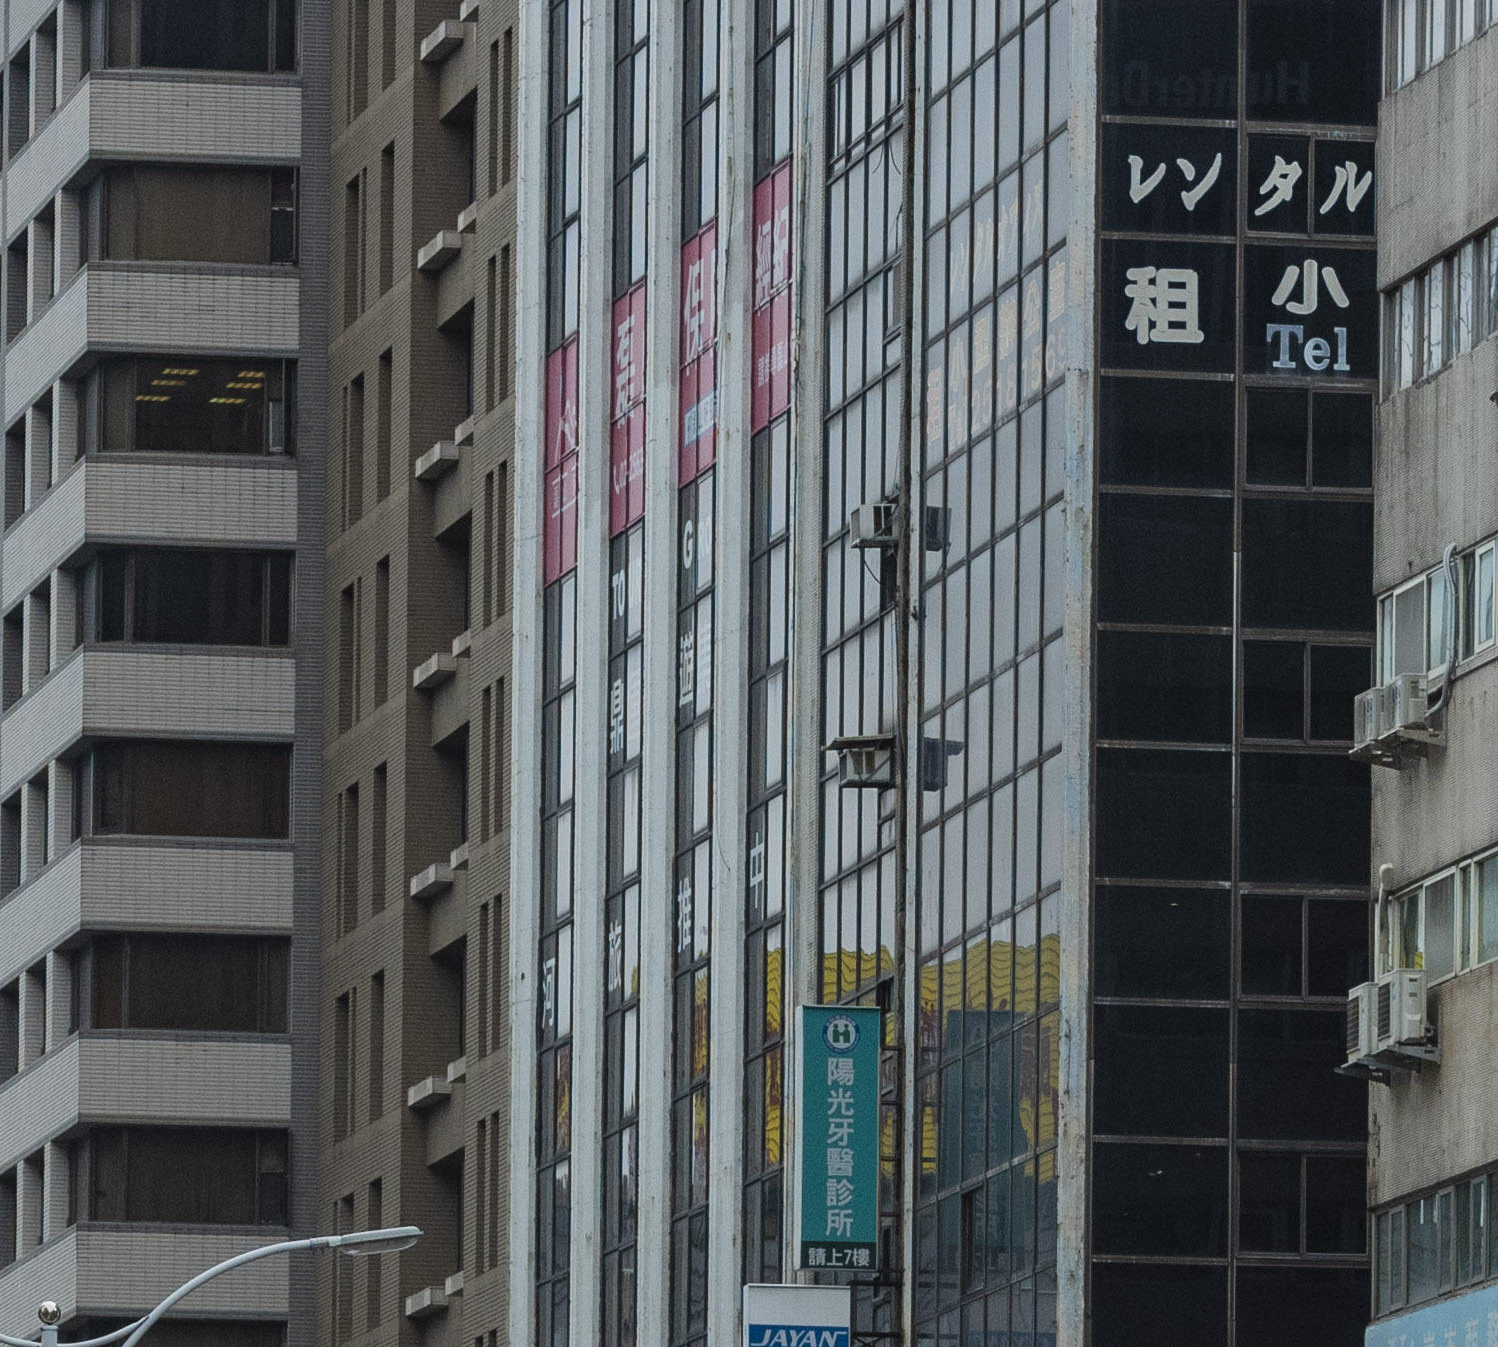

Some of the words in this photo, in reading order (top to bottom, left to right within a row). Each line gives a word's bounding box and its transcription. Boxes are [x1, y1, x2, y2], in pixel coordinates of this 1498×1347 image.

[1128, 152, 1373, 215] レンタル
[1125, 265, 1205, 345] 租
[1271, 258, 1350, 315] 小
[1266, 323, 1351, 371] Tel
[825, 1057, 856, 1238] 陽光牙醫診所
[808, 1247, 871, 1267] 請上7樓
[749, 1328, 847, 1347] JAYAN
